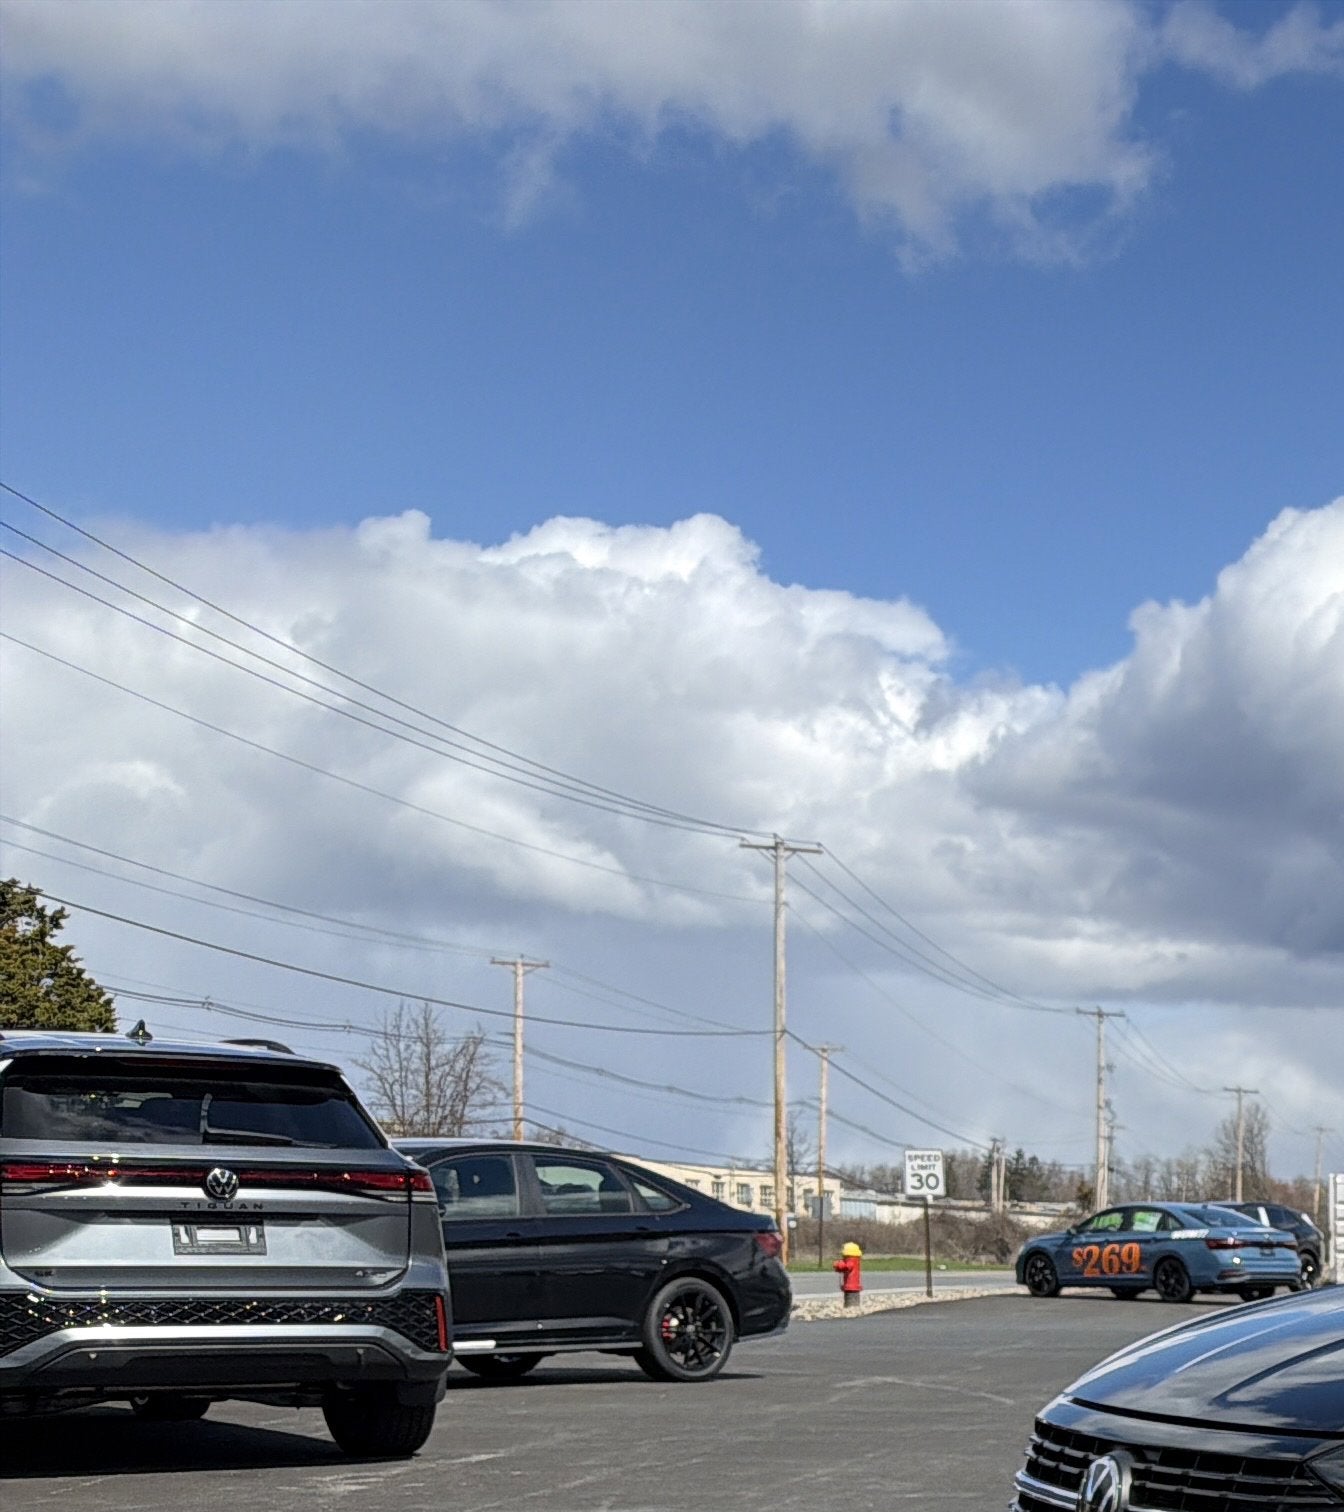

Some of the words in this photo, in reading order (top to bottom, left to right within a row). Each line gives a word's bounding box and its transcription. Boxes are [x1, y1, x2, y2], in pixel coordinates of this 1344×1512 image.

[908, 1154, 941, 1162] SPEED
[911, 1173, 940, 1191] 30
[180, 1201, 264, 1210] TIGUAN
[1073, 1242, 1141, 1278] $269
